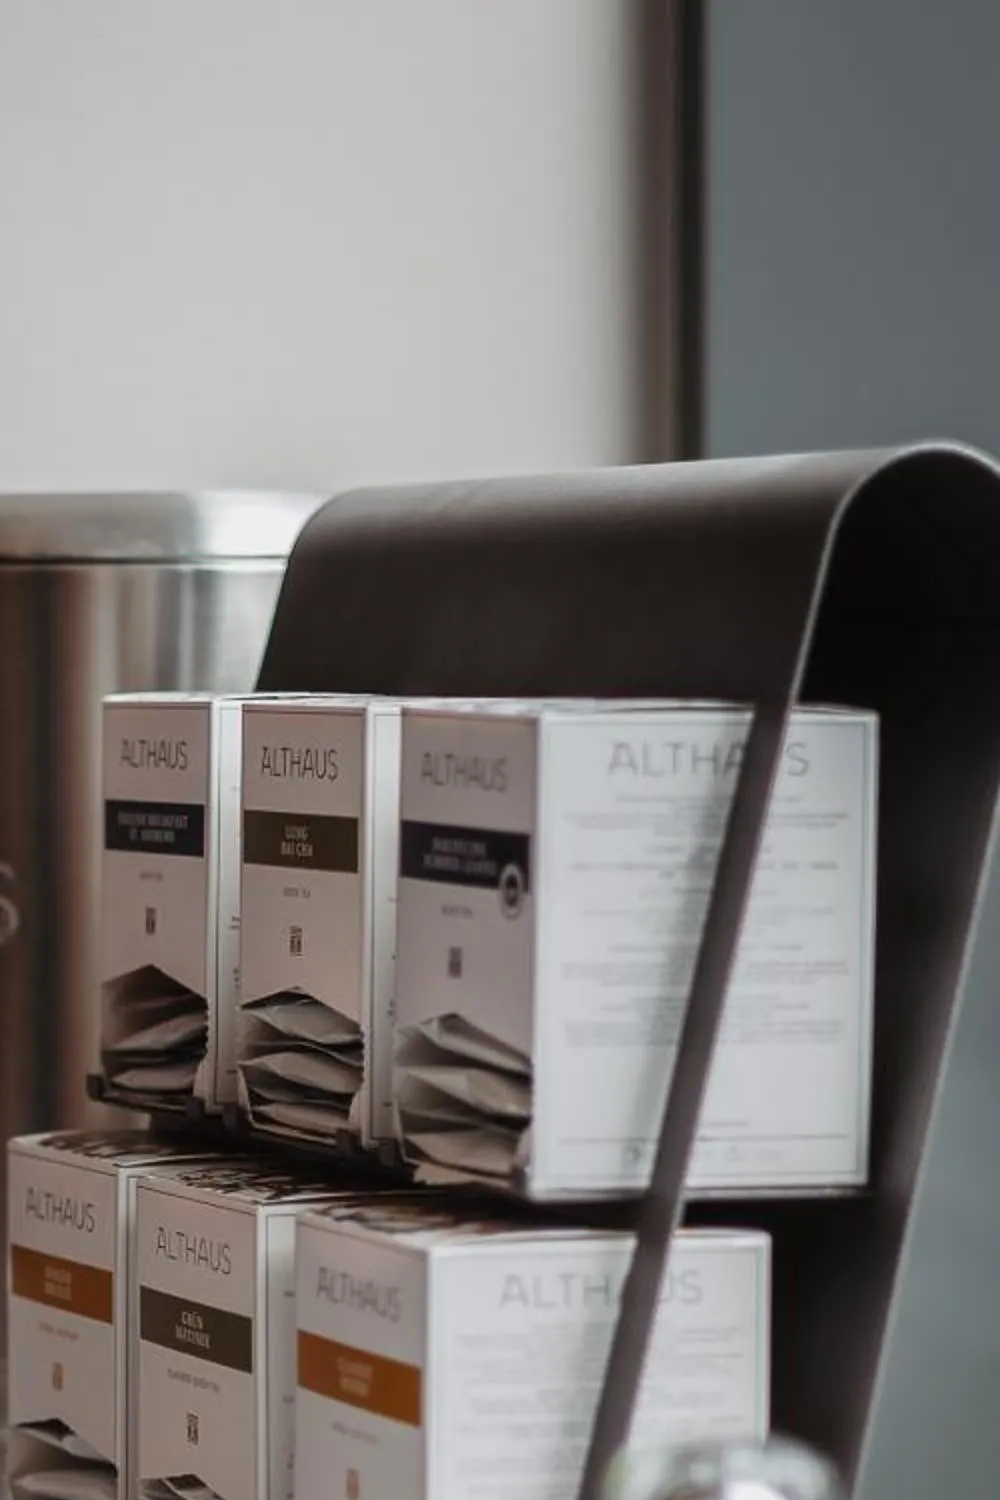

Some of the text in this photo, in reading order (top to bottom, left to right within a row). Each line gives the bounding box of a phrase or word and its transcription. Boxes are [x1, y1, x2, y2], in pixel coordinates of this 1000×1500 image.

[119, 738, 189, 771] ALTHAUS
[260, 745, 339, 781] ALTHAUS
[420, 752, 509, 793] ALTHAUS
[606, 740, 812, 778] ALTHAS
[26, 1187, 96, 1234] ALTHAUS
[155, 1226, 233, 1276] ALTHAUS
[315, 1265, 401, 1324] ALTHAUS
[498, 1269, 704, 1310] ALTHUS
